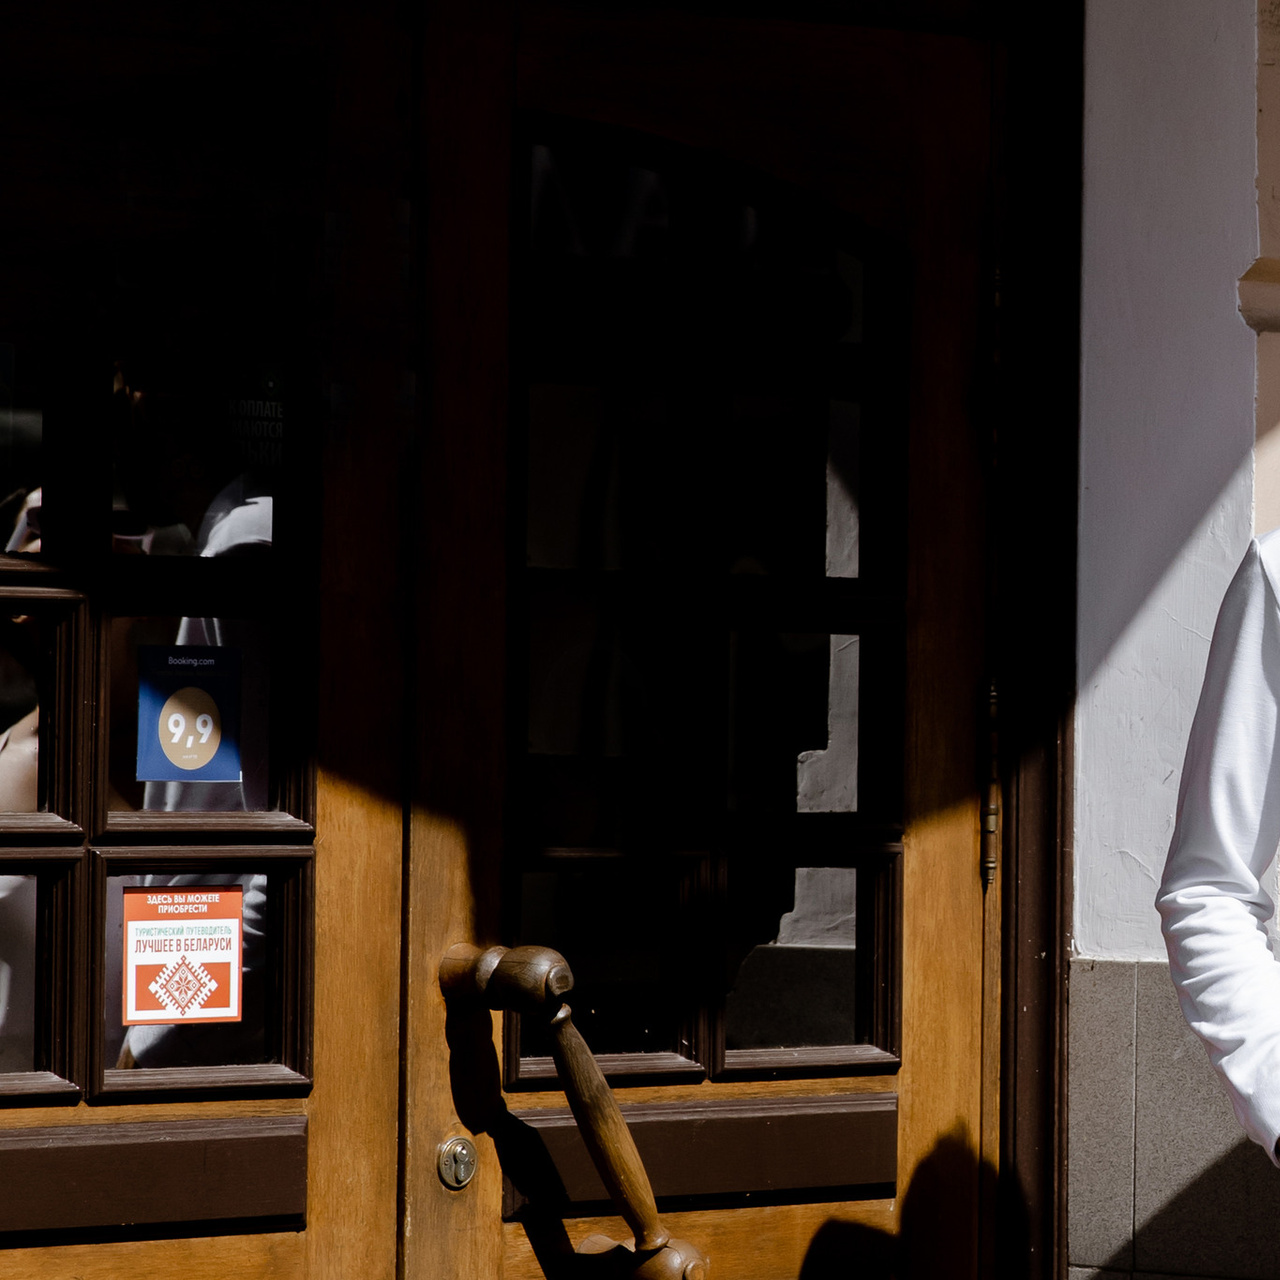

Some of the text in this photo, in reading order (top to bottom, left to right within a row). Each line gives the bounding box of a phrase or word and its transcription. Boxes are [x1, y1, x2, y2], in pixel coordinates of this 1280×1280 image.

[168, 655, 215, 667] Booking.com
[167, 713, 214, 749] 9,9
[147, 894, 220, 904] ЗДЕСЬ ВЫ МОЖЕТЕ
[158, 904, 208, 914] ПРИОБРЕСТИ
[135, 925, 184, 937] ТУРИСТИЧЕСКИЙ
[135, 937, 232, 953] ЛУЧШЕЕ В БЕЛАРУСИ
